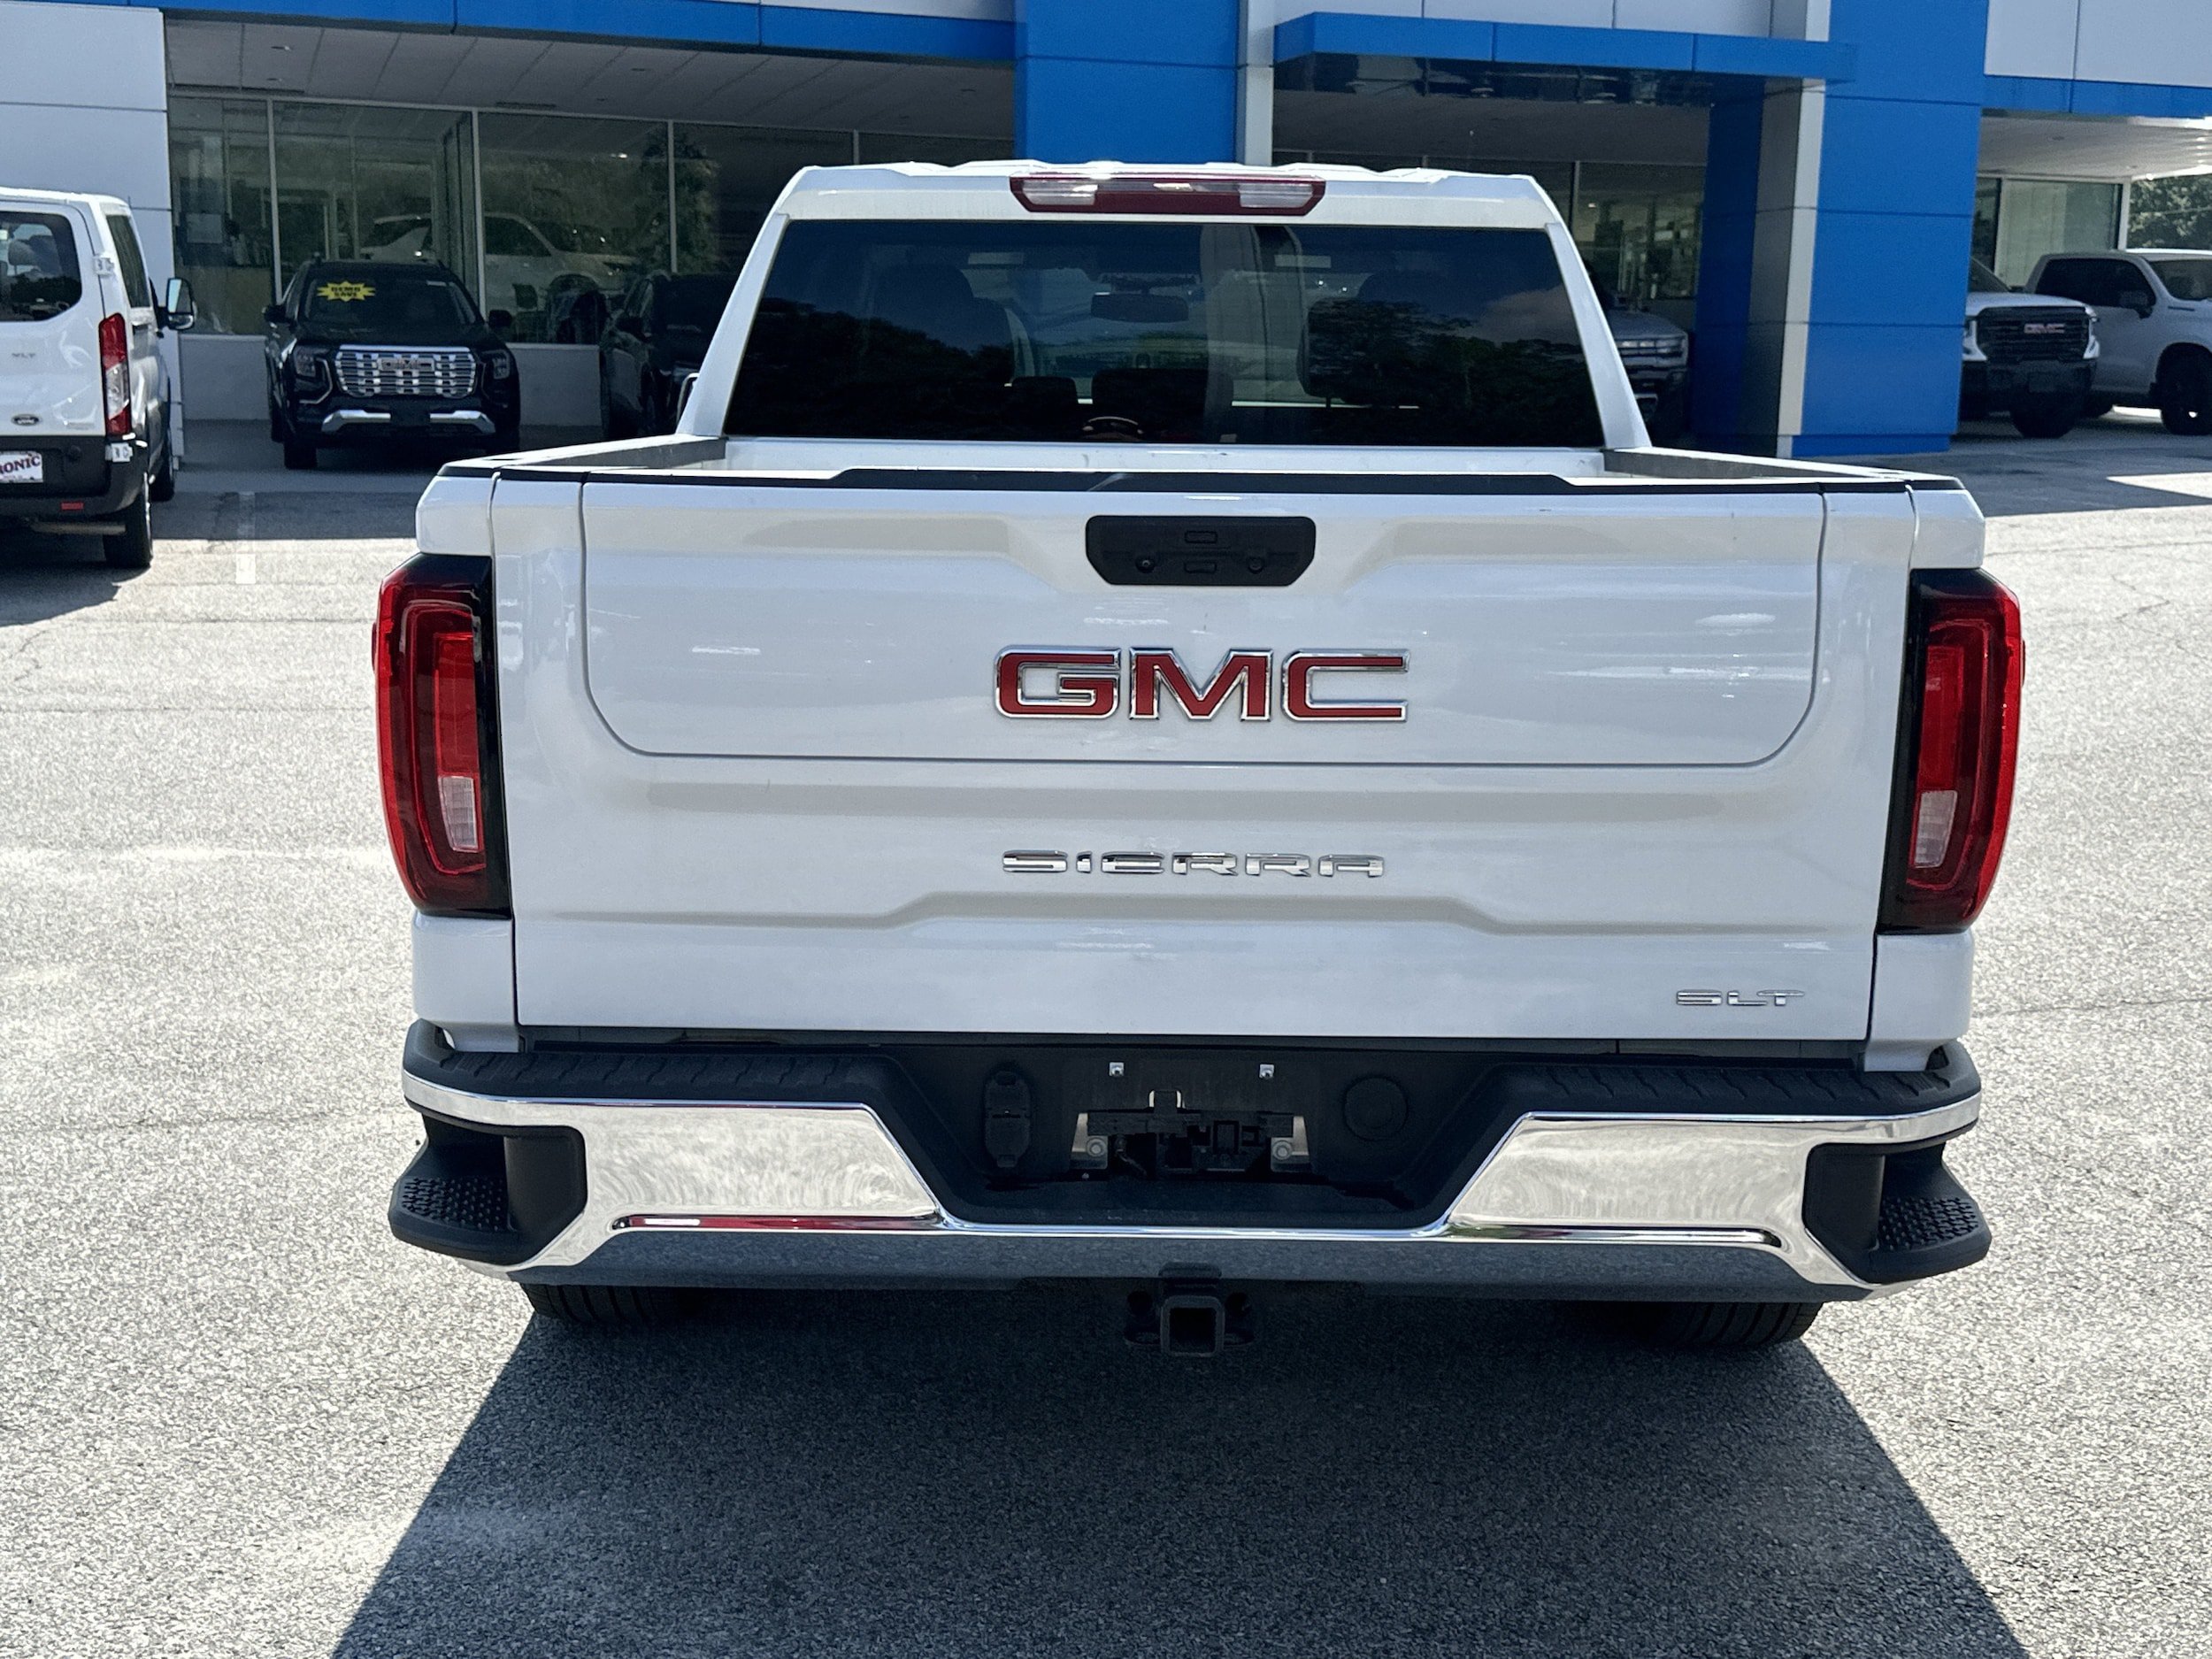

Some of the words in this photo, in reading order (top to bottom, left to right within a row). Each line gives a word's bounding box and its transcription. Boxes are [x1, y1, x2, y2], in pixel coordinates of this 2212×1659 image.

[2024, 323, 2066, 334] GMC
[995, 645, 1410, 722] GMC
[1002, 849, 1386, 877] SIERRA
[1677, 989, 1805, 1006] SLT
